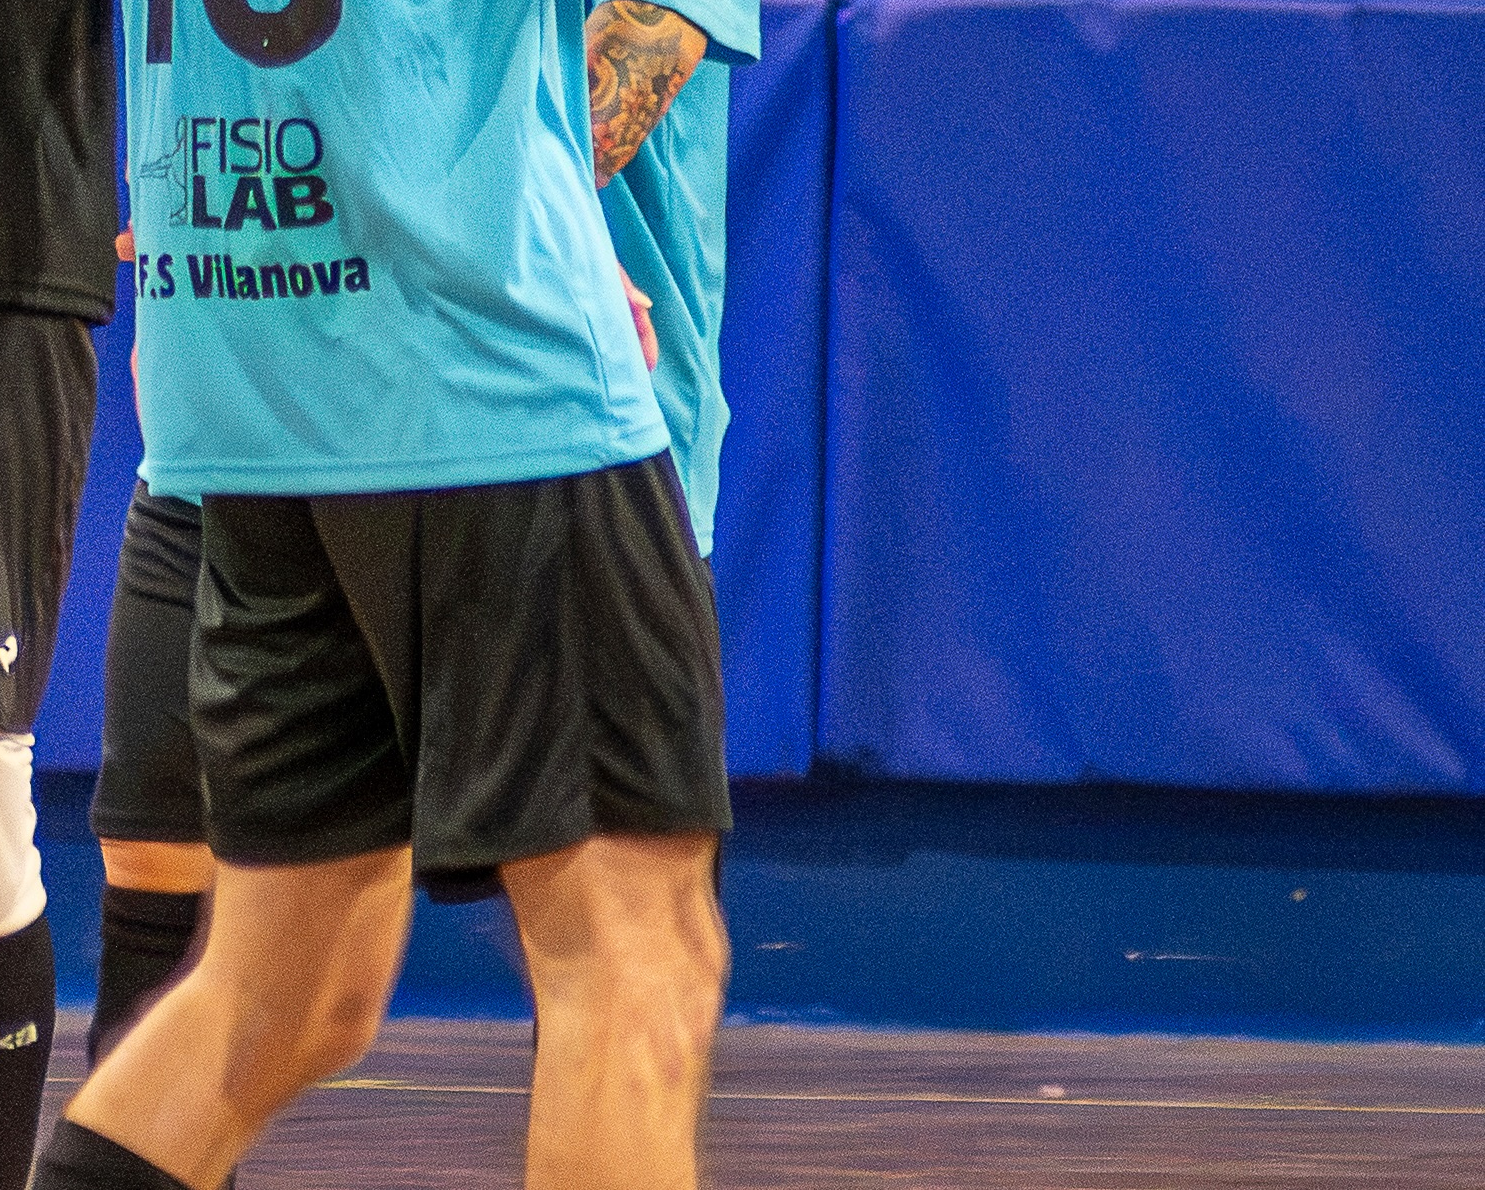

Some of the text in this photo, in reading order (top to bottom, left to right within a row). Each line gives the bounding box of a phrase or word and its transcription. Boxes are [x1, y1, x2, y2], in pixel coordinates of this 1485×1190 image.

[191, 117, 324, 174] FISIO
[192, 175, 334, 231] LAB
[186, 253, 370, 300] Vilanova
